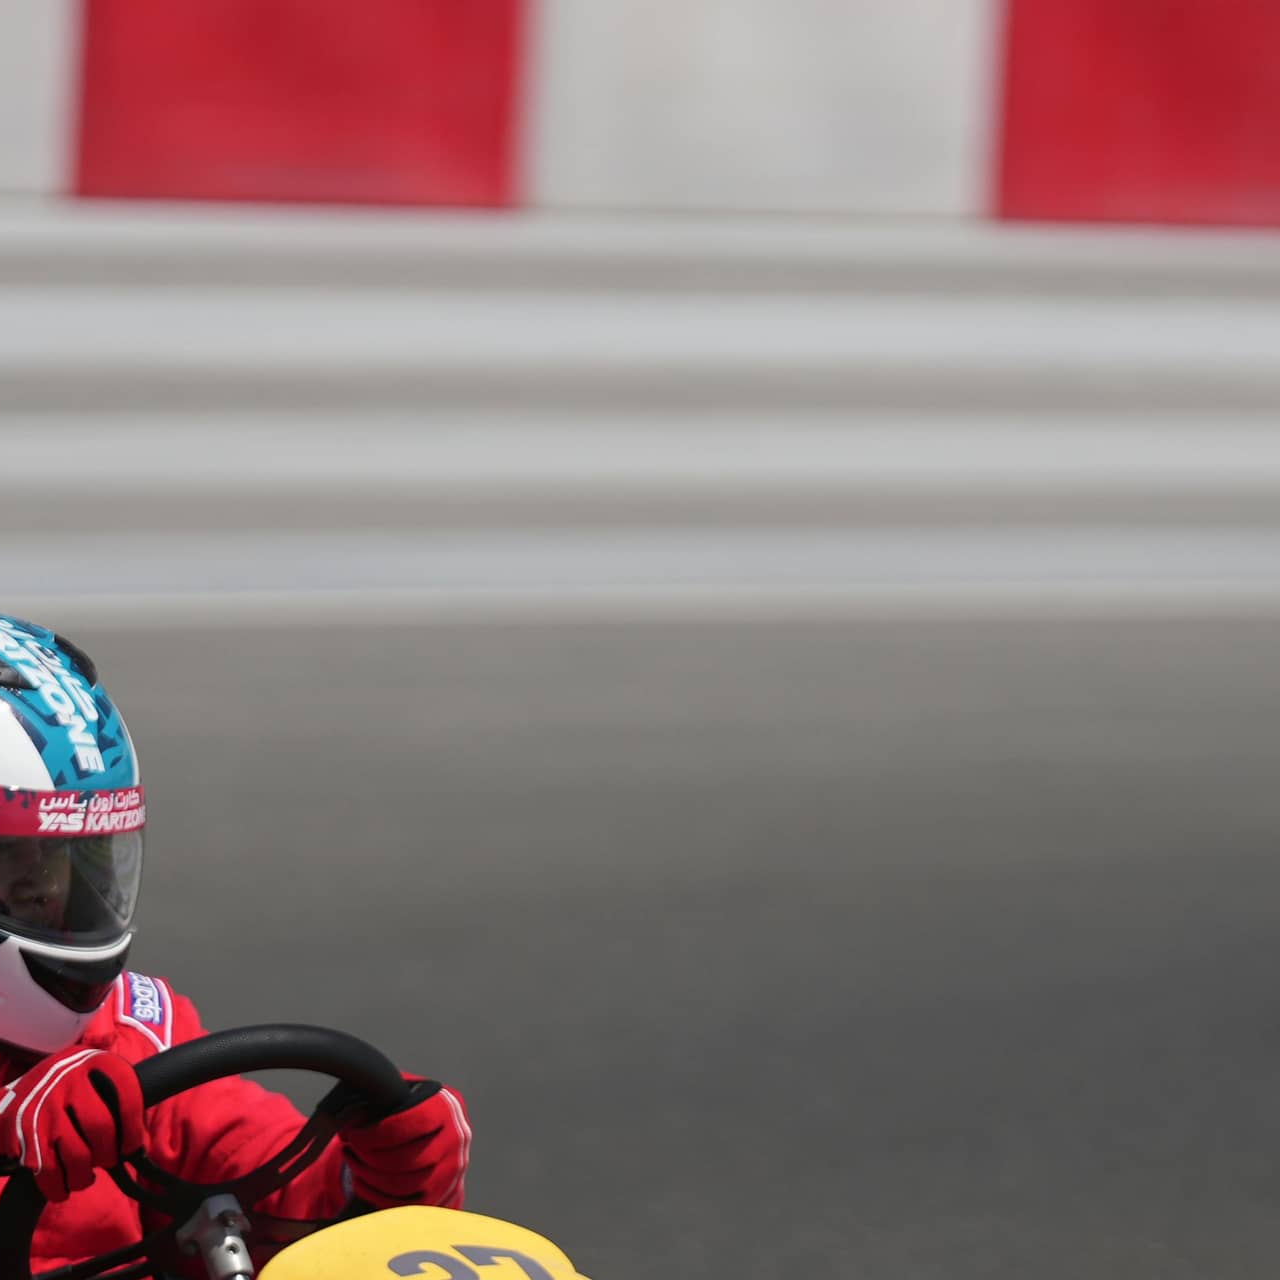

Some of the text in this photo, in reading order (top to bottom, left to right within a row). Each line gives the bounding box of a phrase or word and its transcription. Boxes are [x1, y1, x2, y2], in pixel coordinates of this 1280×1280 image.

[38, 806, 145, 832] YAS KARTZON
[128, 972, 162, 1024] sparc
